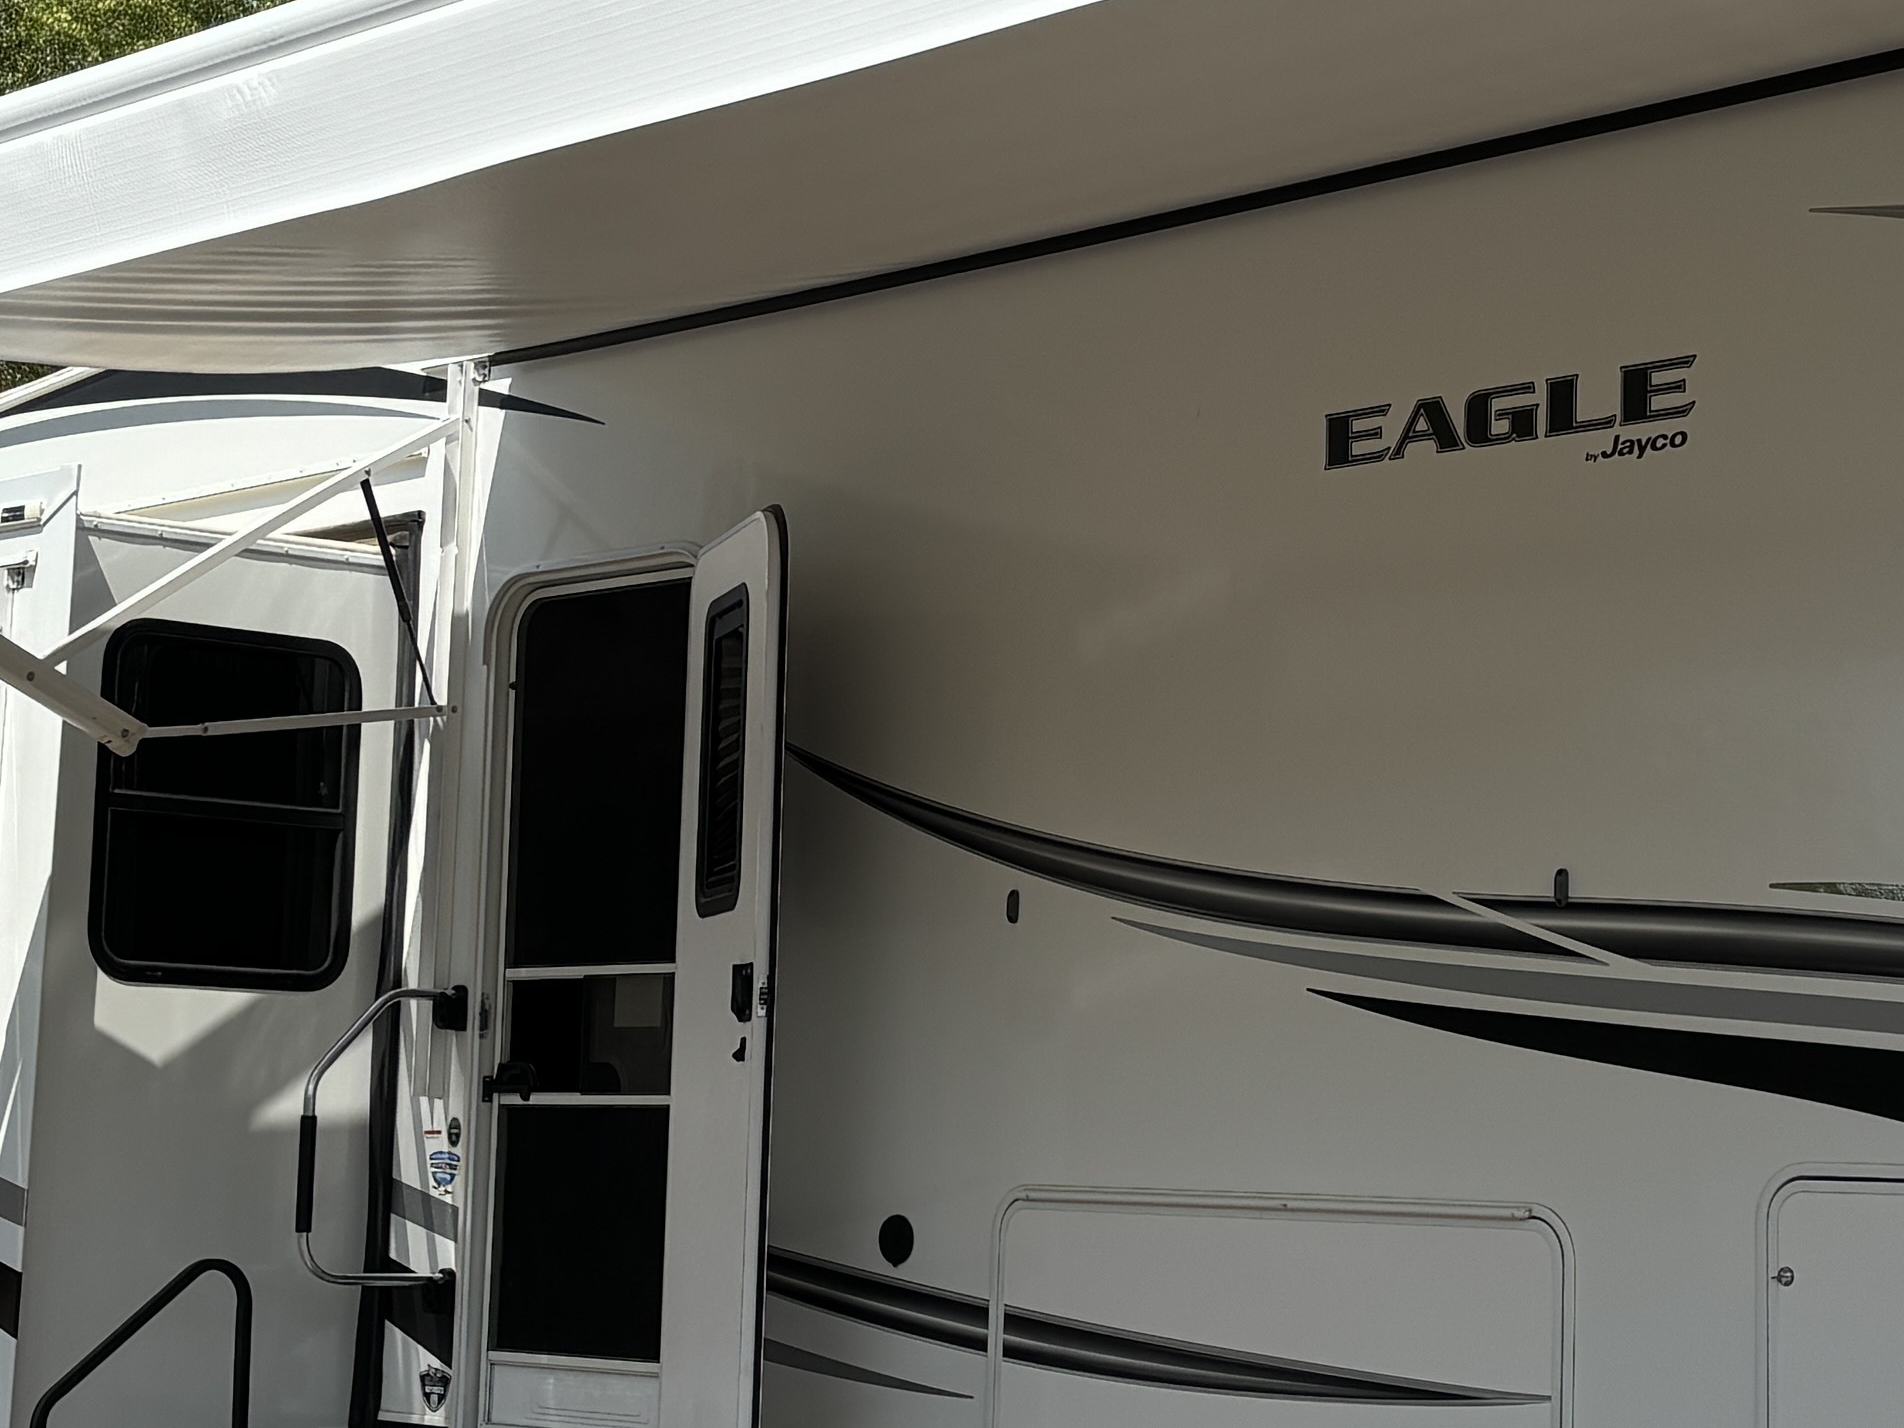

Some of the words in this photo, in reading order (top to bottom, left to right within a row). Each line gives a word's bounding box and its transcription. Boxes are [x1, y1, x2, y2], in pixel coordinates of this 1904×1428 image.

[1323, 353, 1697, 470] EAGLE
[1584, 451, 1600, 463] by
[1600, 429, 1688, 462] Jayco
